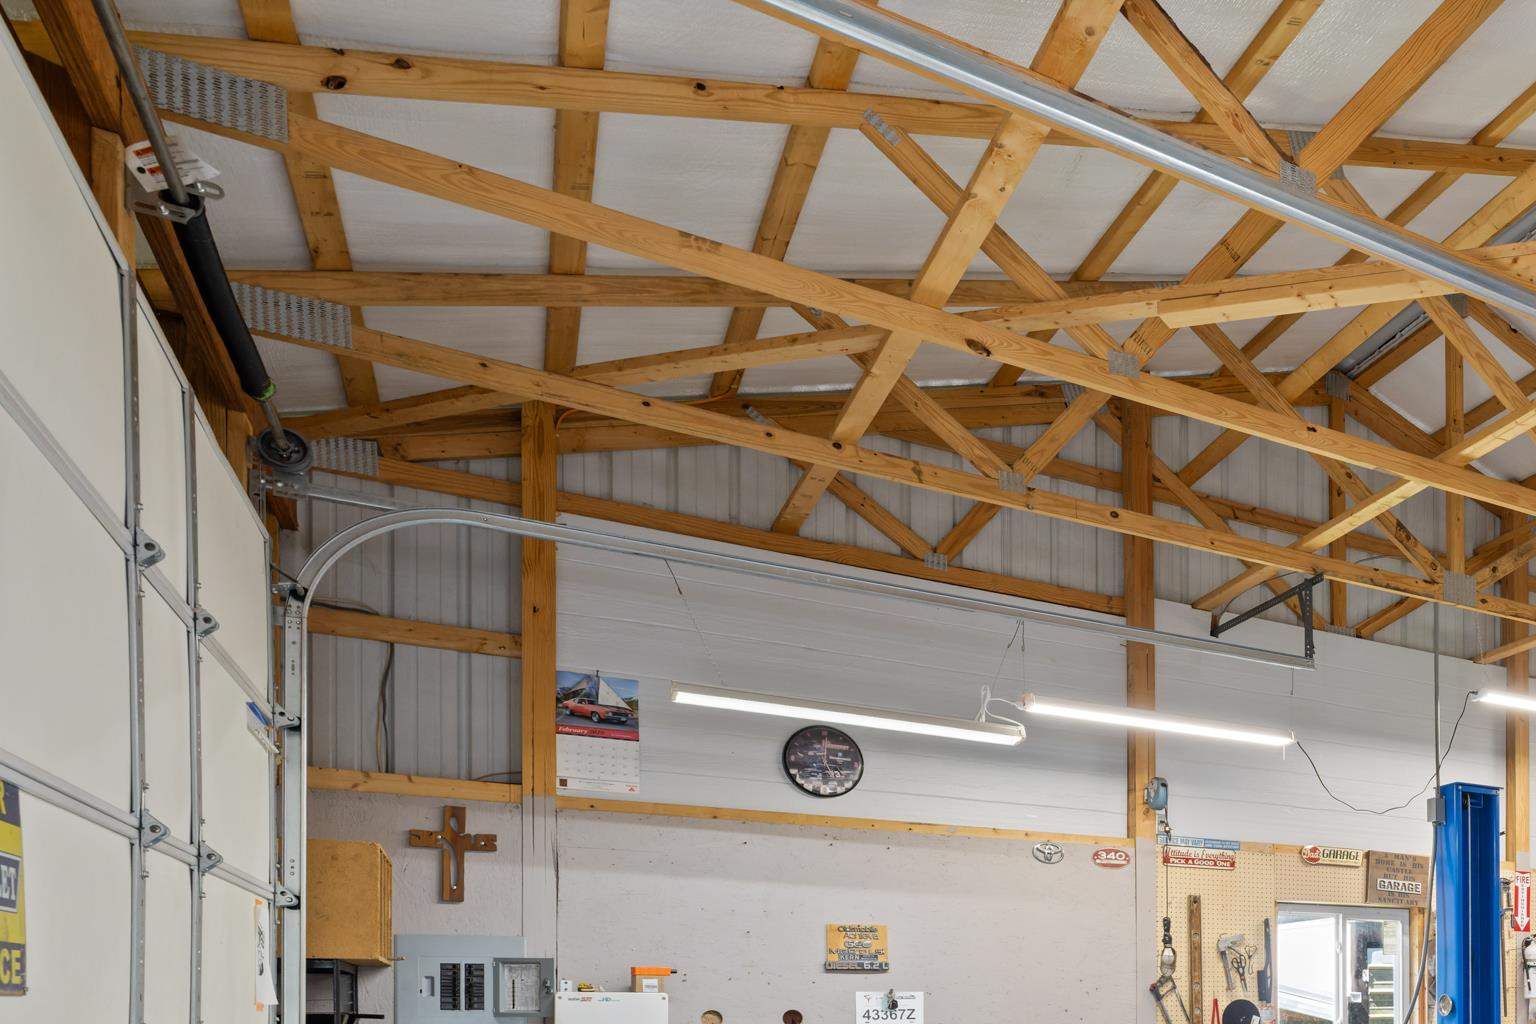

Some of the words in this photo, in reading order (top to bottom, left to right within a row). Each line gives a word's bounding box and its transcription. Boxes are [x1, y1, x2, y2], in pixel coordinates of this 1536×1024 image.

[1098, 852, 1125, 860] 340
[1322, 849, 1360, 860] GARAGE
[1516, 875, 1529, 884] FIRE
[1378, 880, 1421, 893] GARAGE
[862, 1008, 916, 1021] 43367Z
